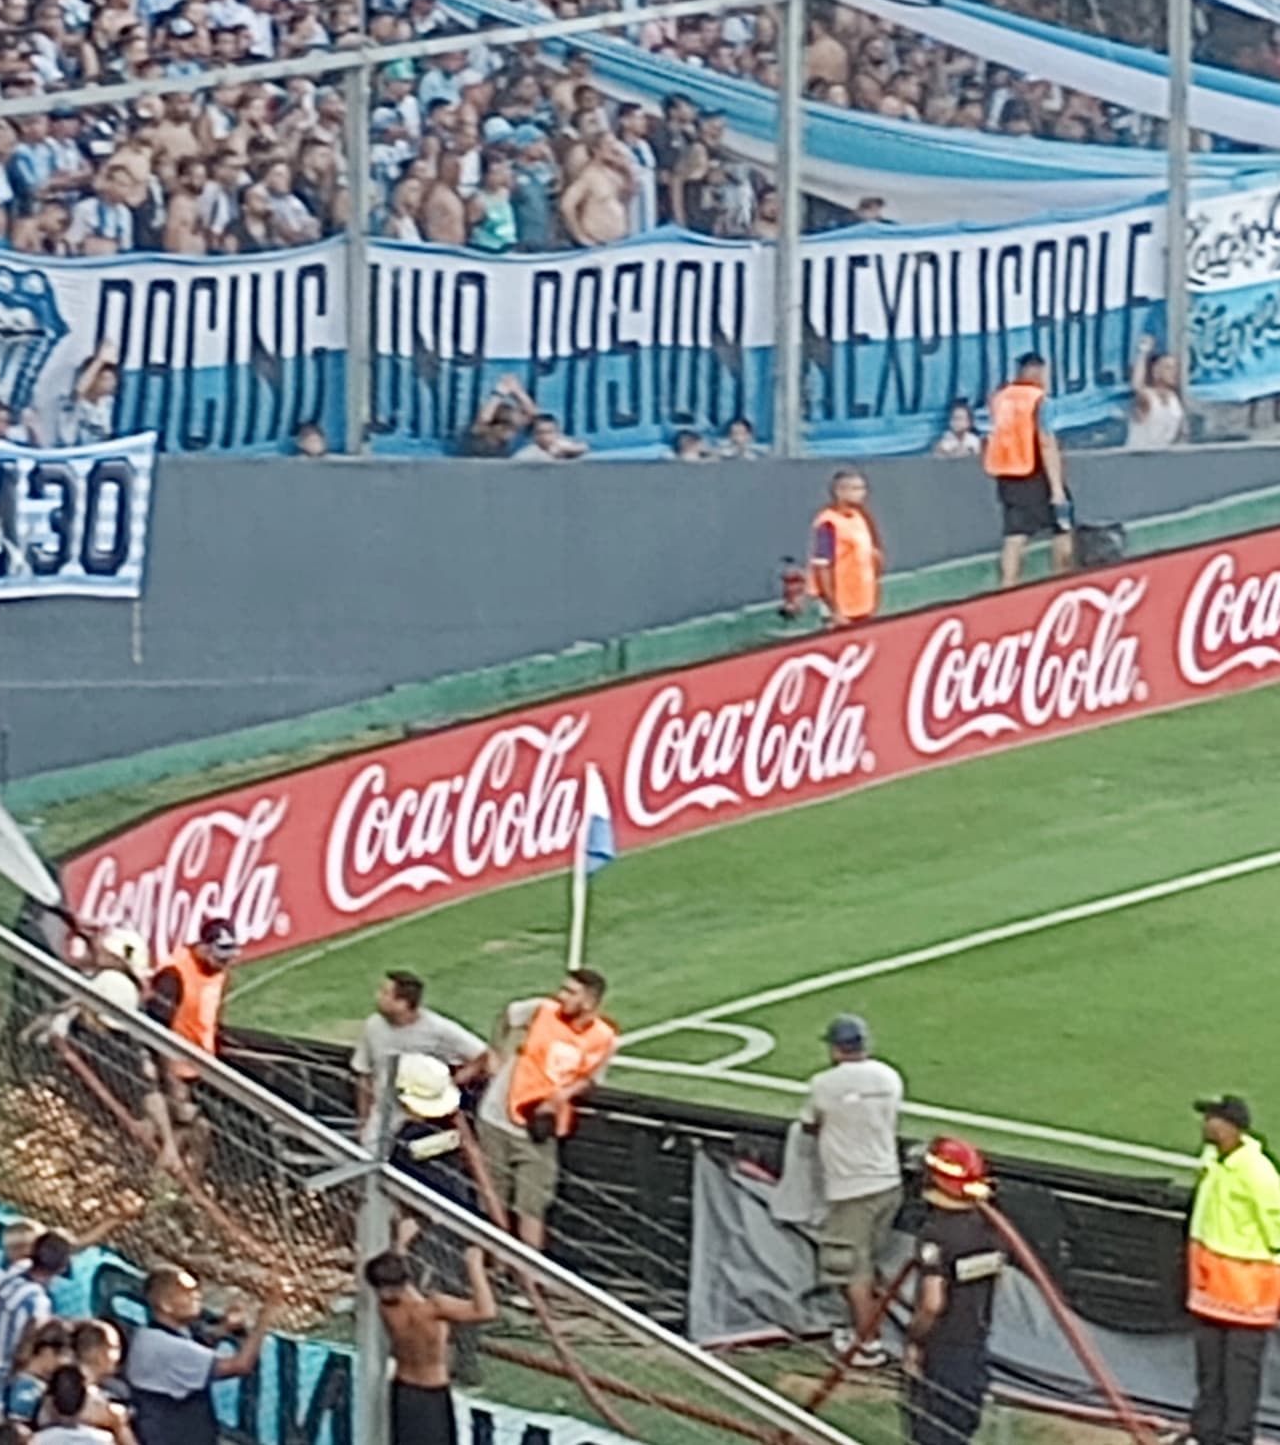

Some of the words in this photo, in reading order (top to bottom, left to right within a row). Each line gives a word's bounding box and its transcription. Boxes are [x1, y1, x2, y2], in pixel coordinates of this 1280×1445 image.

[98, 262, 328, 451] RACING
[530, 258, 746, 434] PASION
[801, 220, 1153, 421] NEXPLICABLE
[625, 637, 877, 829] Coca-Cola
[907, 576, 1149, 754] Coca-Cola
[326, 711, 592, 912] Coca-Cola
